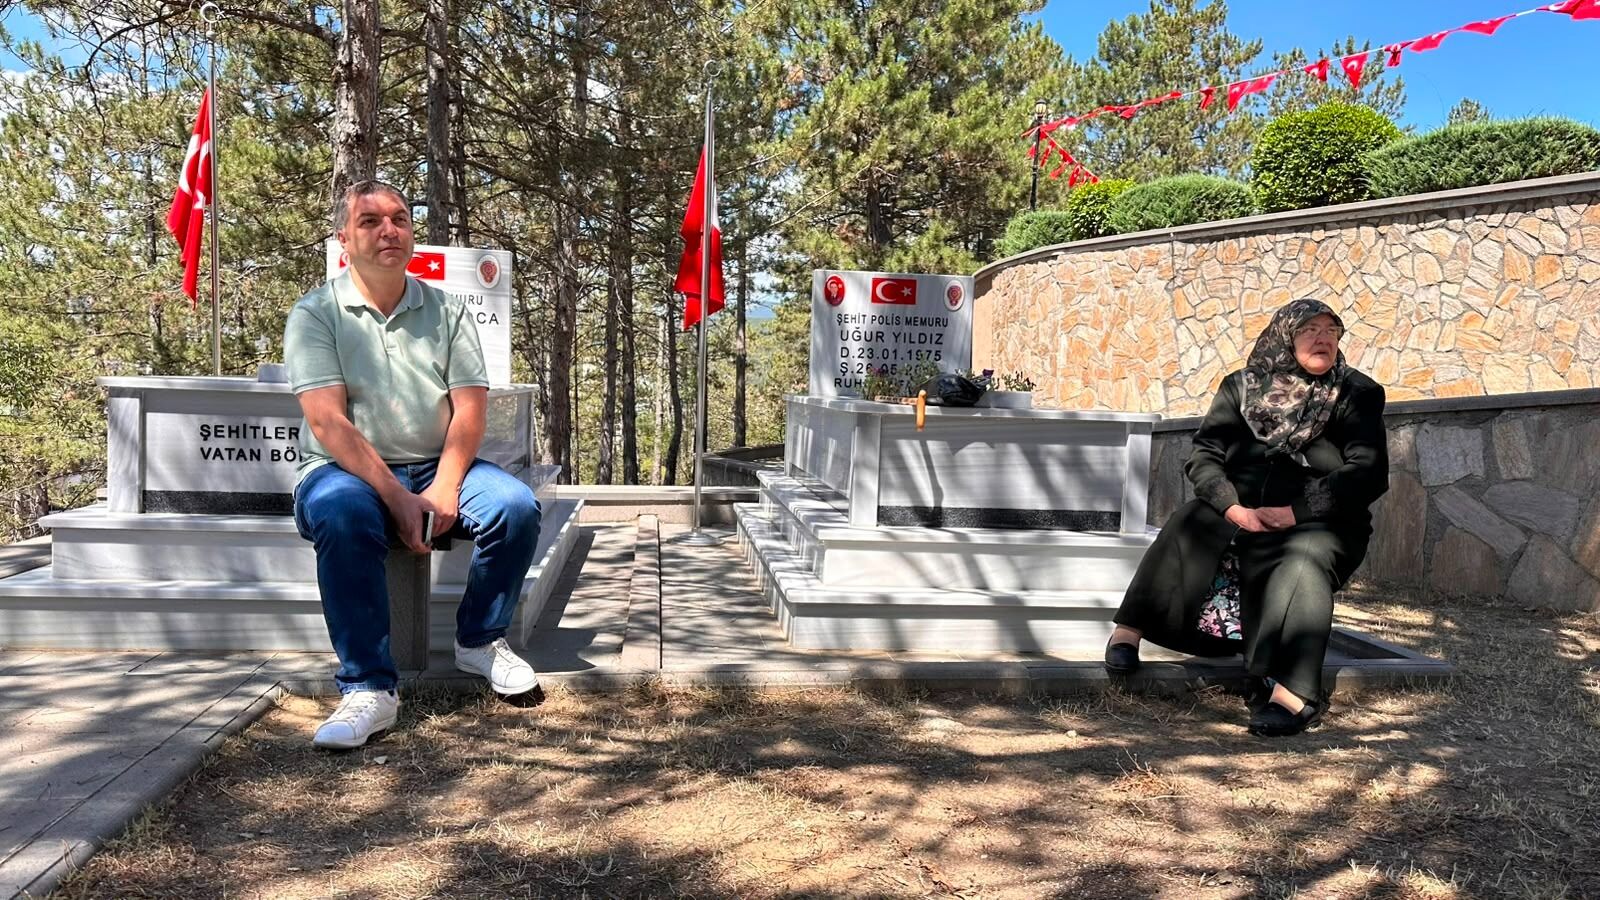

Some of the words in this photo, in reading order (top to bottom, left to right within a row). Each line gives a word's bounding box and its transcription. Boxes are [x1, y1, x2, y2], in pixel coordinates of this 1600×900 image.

[836, 313, 867, 325] ŞEHİT
[871, 313, 901, 326] POLİS
[904, 316, 949, 328] MEMURU
[840, 327, 885, 343] UĞUR
[892, 331, 944, 345] YILDIZ
[840, 347, 942, 361] D.23.01.1975
[199, 424, 300, 441] ŞEHİTLER
[200, 447, 261, 462] VATAN
